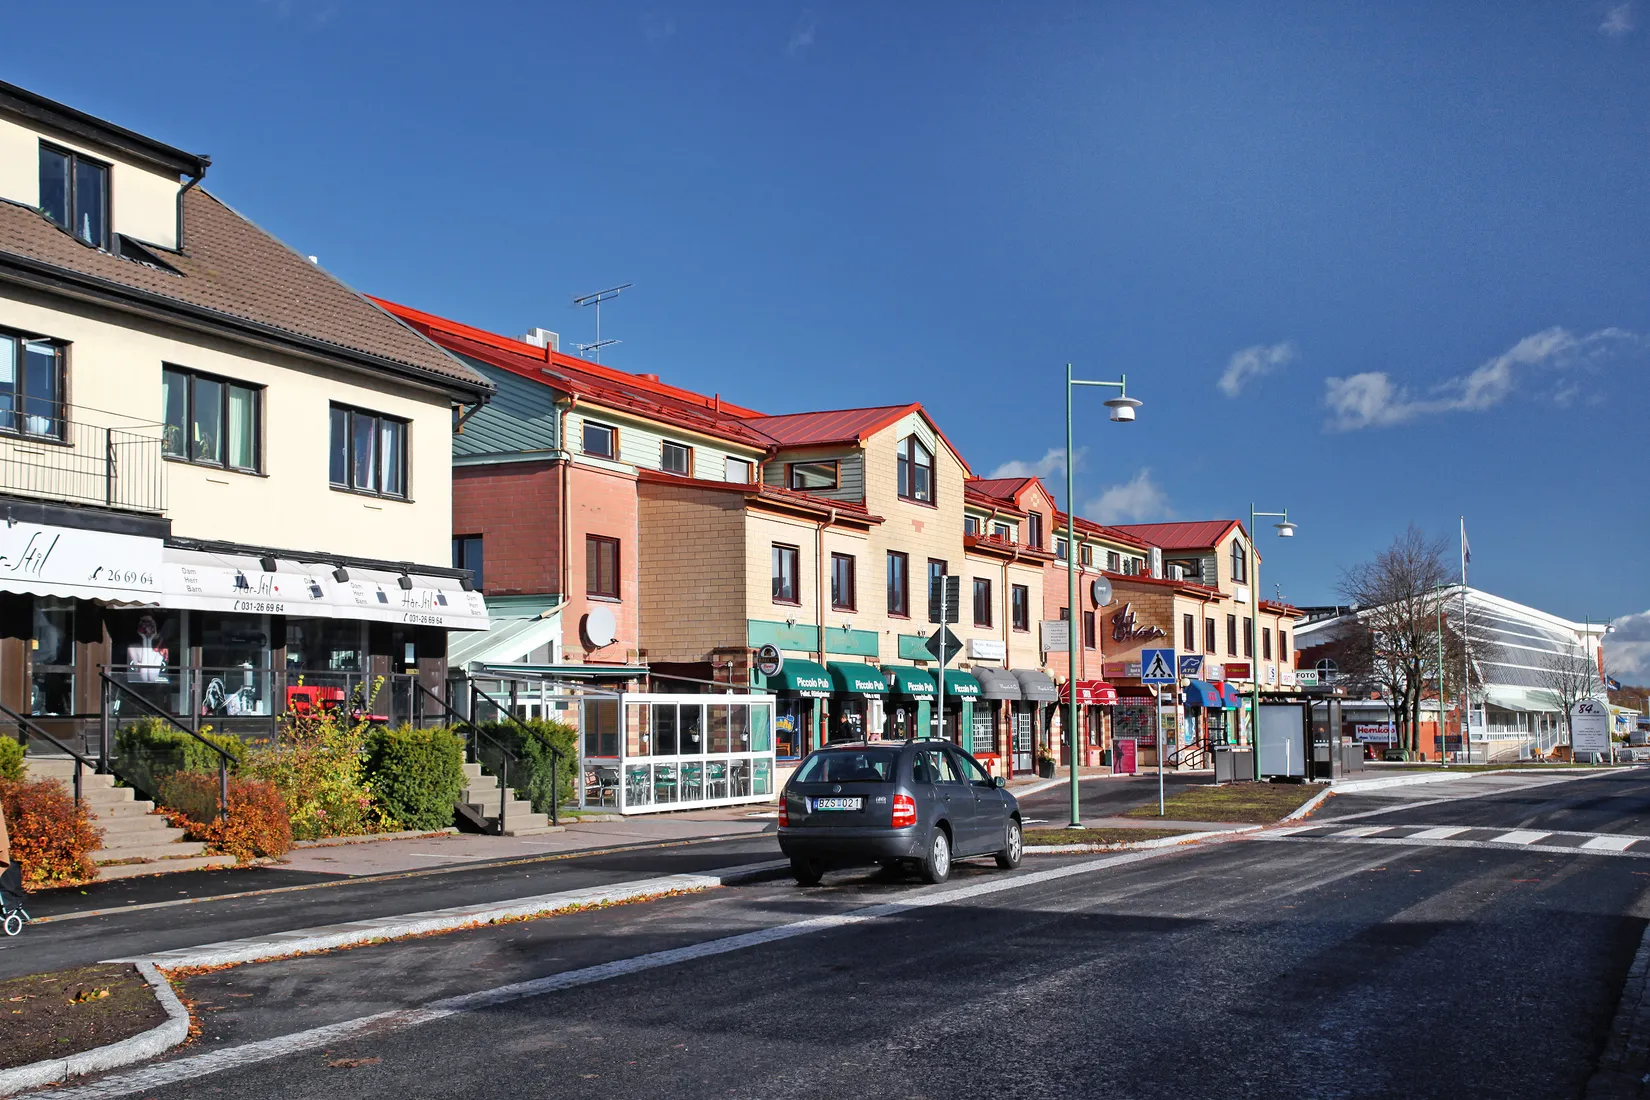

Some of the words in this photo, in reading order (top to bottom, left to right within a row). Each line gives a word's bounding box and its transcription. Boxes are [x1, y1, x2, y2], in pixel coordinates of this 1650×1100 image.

[181, 567, 196, 575] Dam
[108, 569, 121, 582] 26
[124, 570, 137, 584] 69
[140, 572, 153, 585] 64
[184, 576, 198, 584] Herr
[186, 585, 203, 593] Barn
[241, 601, 265, 612] 031-26
[266, 603, 275, 612] 69
[276, 604, 284, 612] 64
[409, 614, 428, 624] 031-26
[818, 678, 829, 688] Pub
[874, 681, 884, 690] Pub
[924, 682, 934, 692] Pub
[970, 685, 978, 693] Pub
[819, 798, 836, 808] BZS
[842, 798, 859, 808] 021
